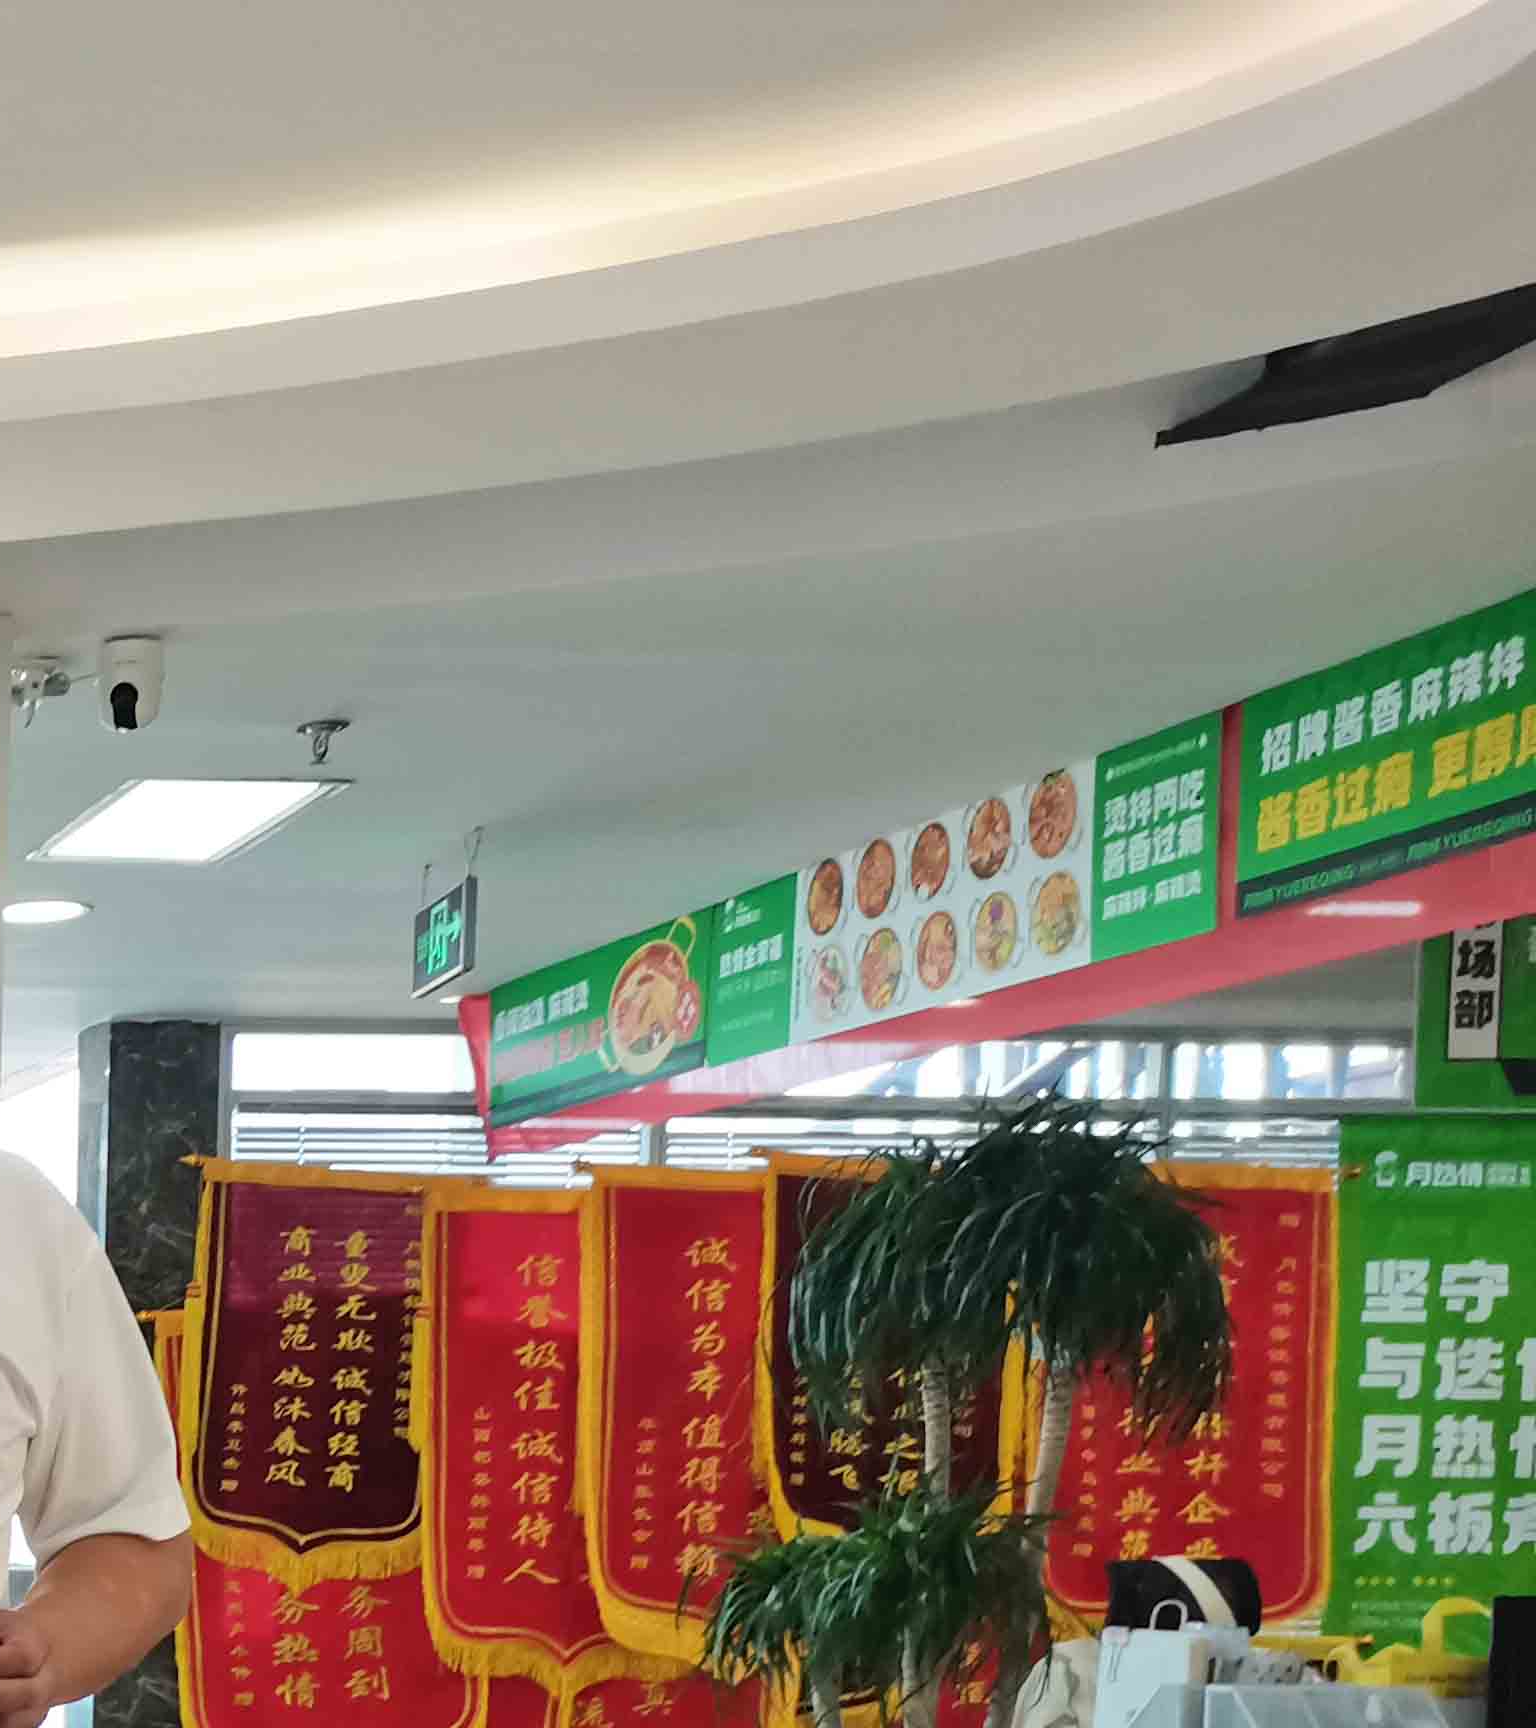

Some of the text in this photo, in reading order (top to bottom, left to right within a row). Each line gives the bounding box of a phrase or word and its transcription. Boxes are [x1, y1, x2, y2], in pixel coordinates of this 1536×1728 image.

[1259, 635, 1526, 777] 招牌酱香麻辣拌
[1455, 922, 1497, 1030] 场部
[1361, 1259, 1510, 1323] 坚守
